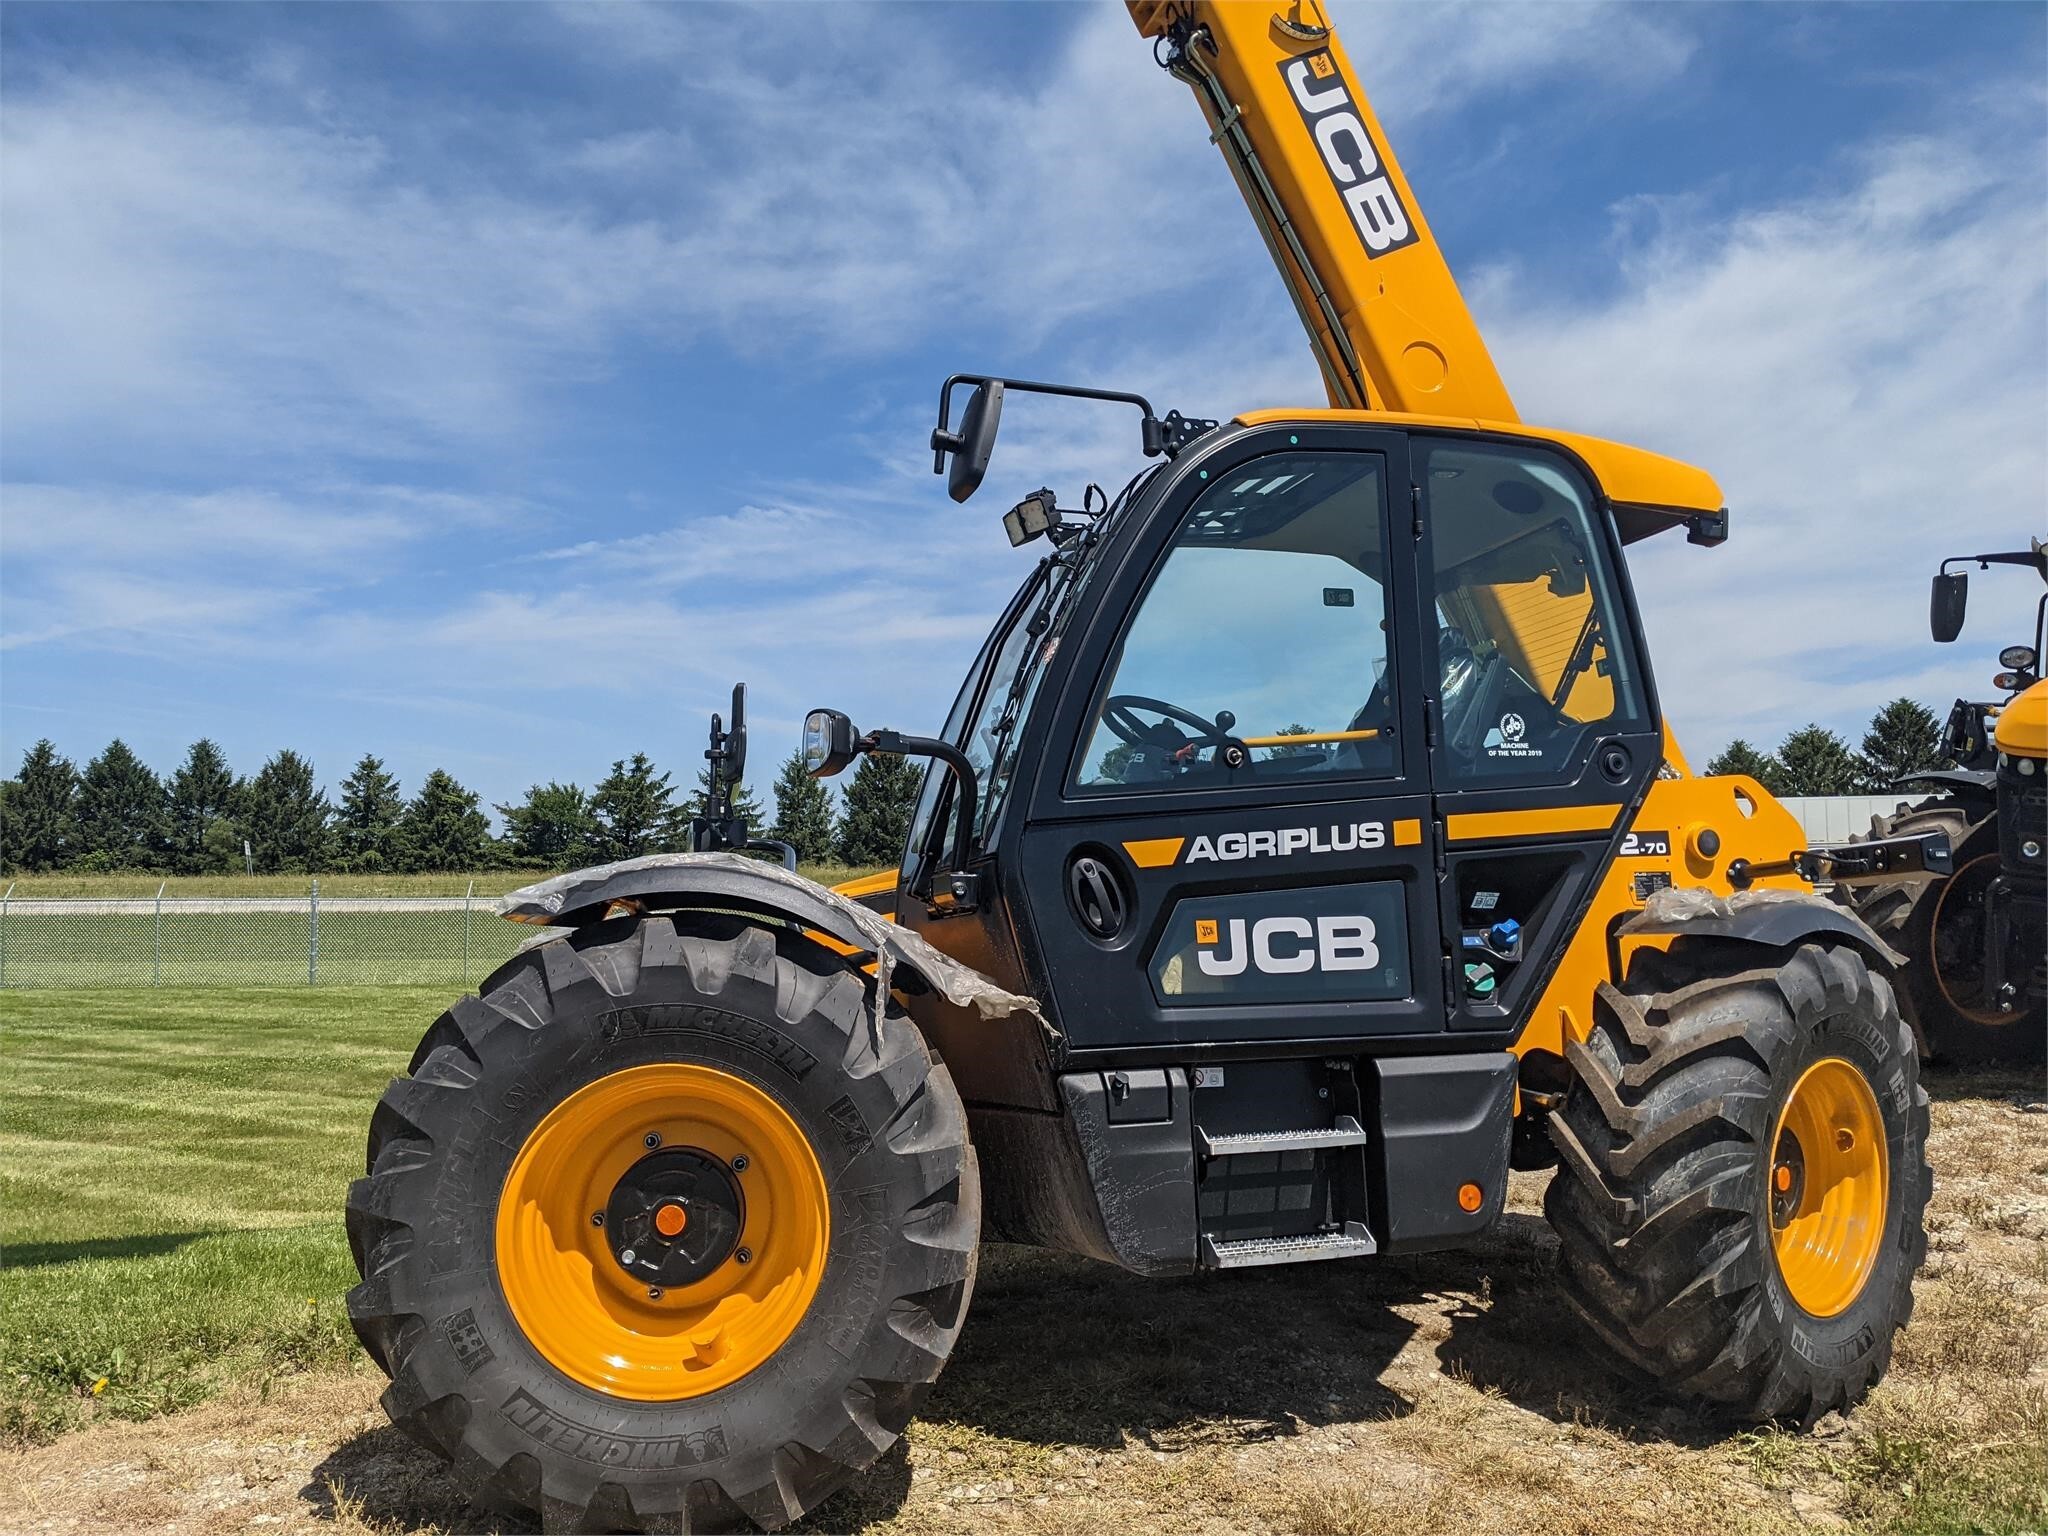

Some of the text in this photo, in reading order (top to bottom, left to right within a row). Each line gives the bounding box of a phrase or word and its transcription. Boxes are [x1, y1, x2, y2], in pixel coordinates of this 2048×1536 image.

[1287, 60, 1409, 250] JCB
[1185, 821, 1386, 864] AGRIPLUS
[1197, 914, 1380, 976] JCB
[646, 1006, 816, 1074] MICHELIN
[501, 1396, 681, 1467] MICHELIN
